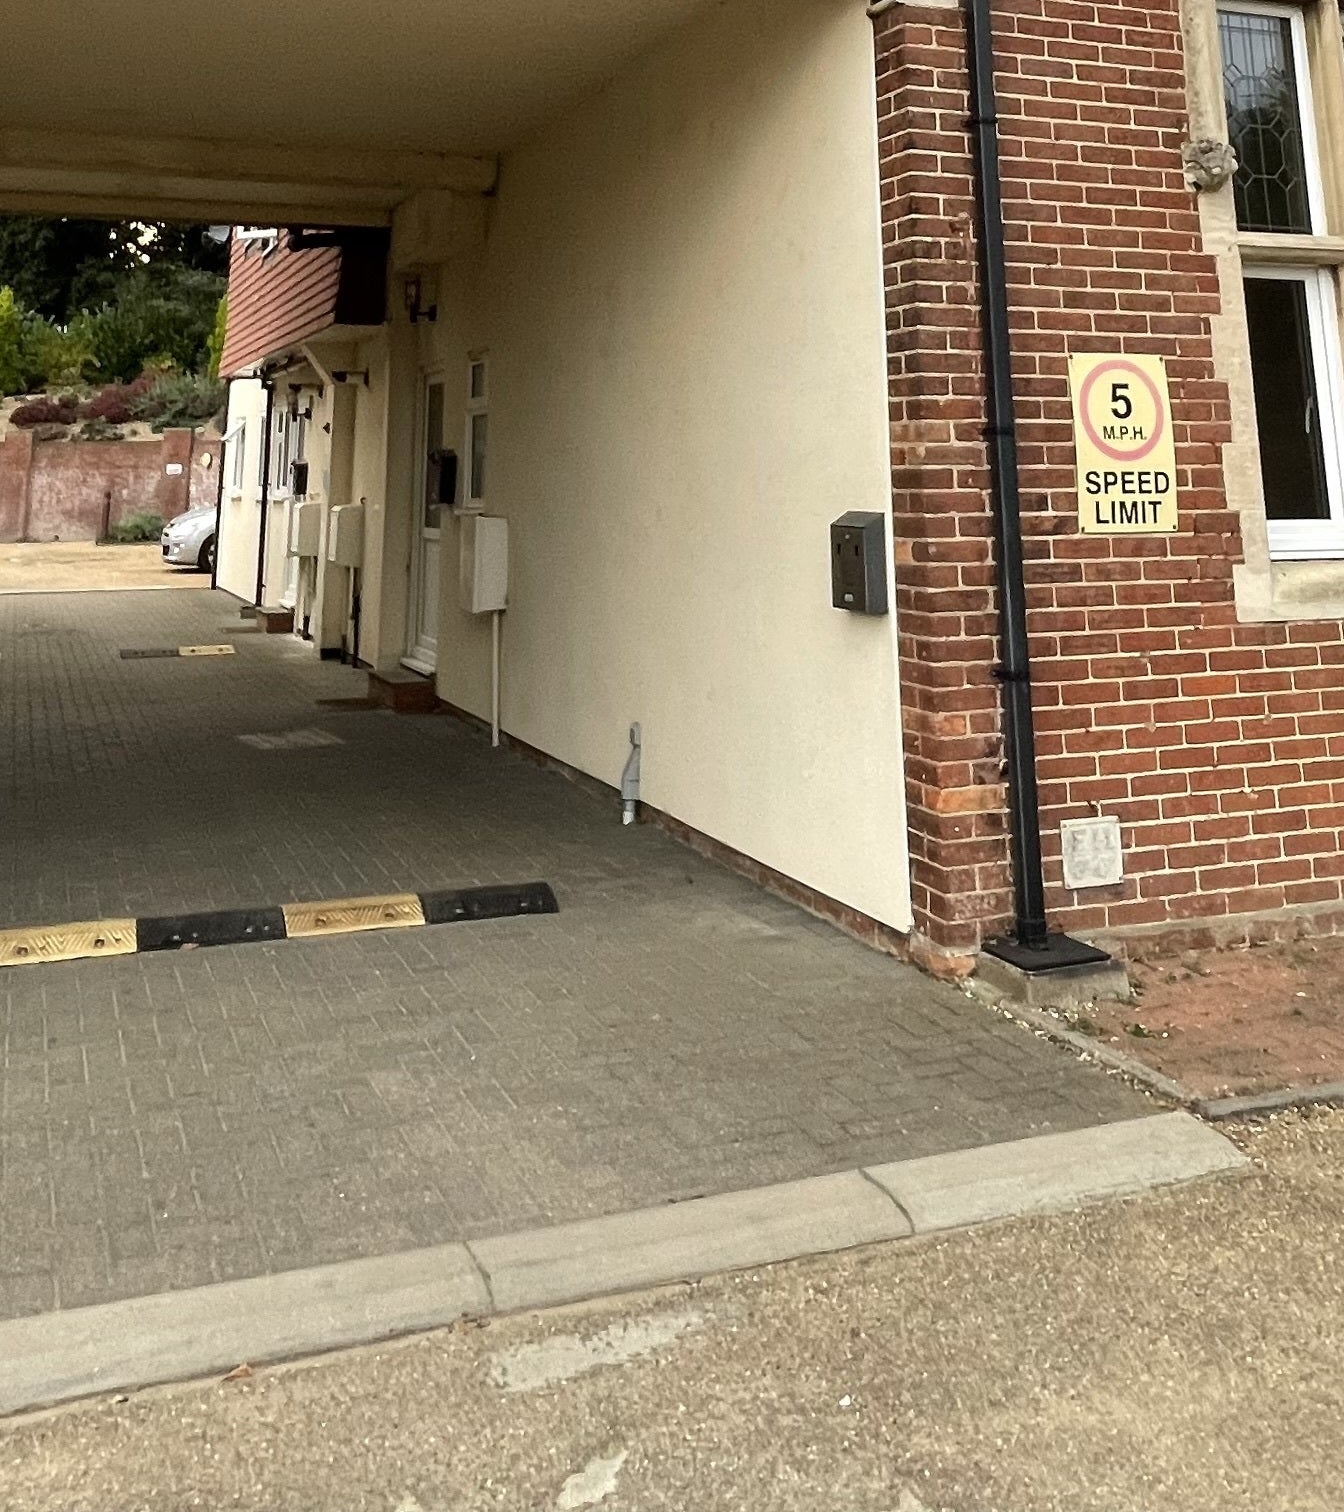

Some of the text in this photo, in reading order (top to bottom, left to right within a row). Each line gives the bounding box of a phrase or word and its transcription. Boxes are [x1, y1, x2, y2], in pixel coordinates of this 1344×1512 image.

[1110, 383, 1133, 419] 5
[1103, 425, 1148, 441] M.P.H.
[1085, 471, 1170, 495] SPEED
[1095, 500, 1162, 524] LIMIT
